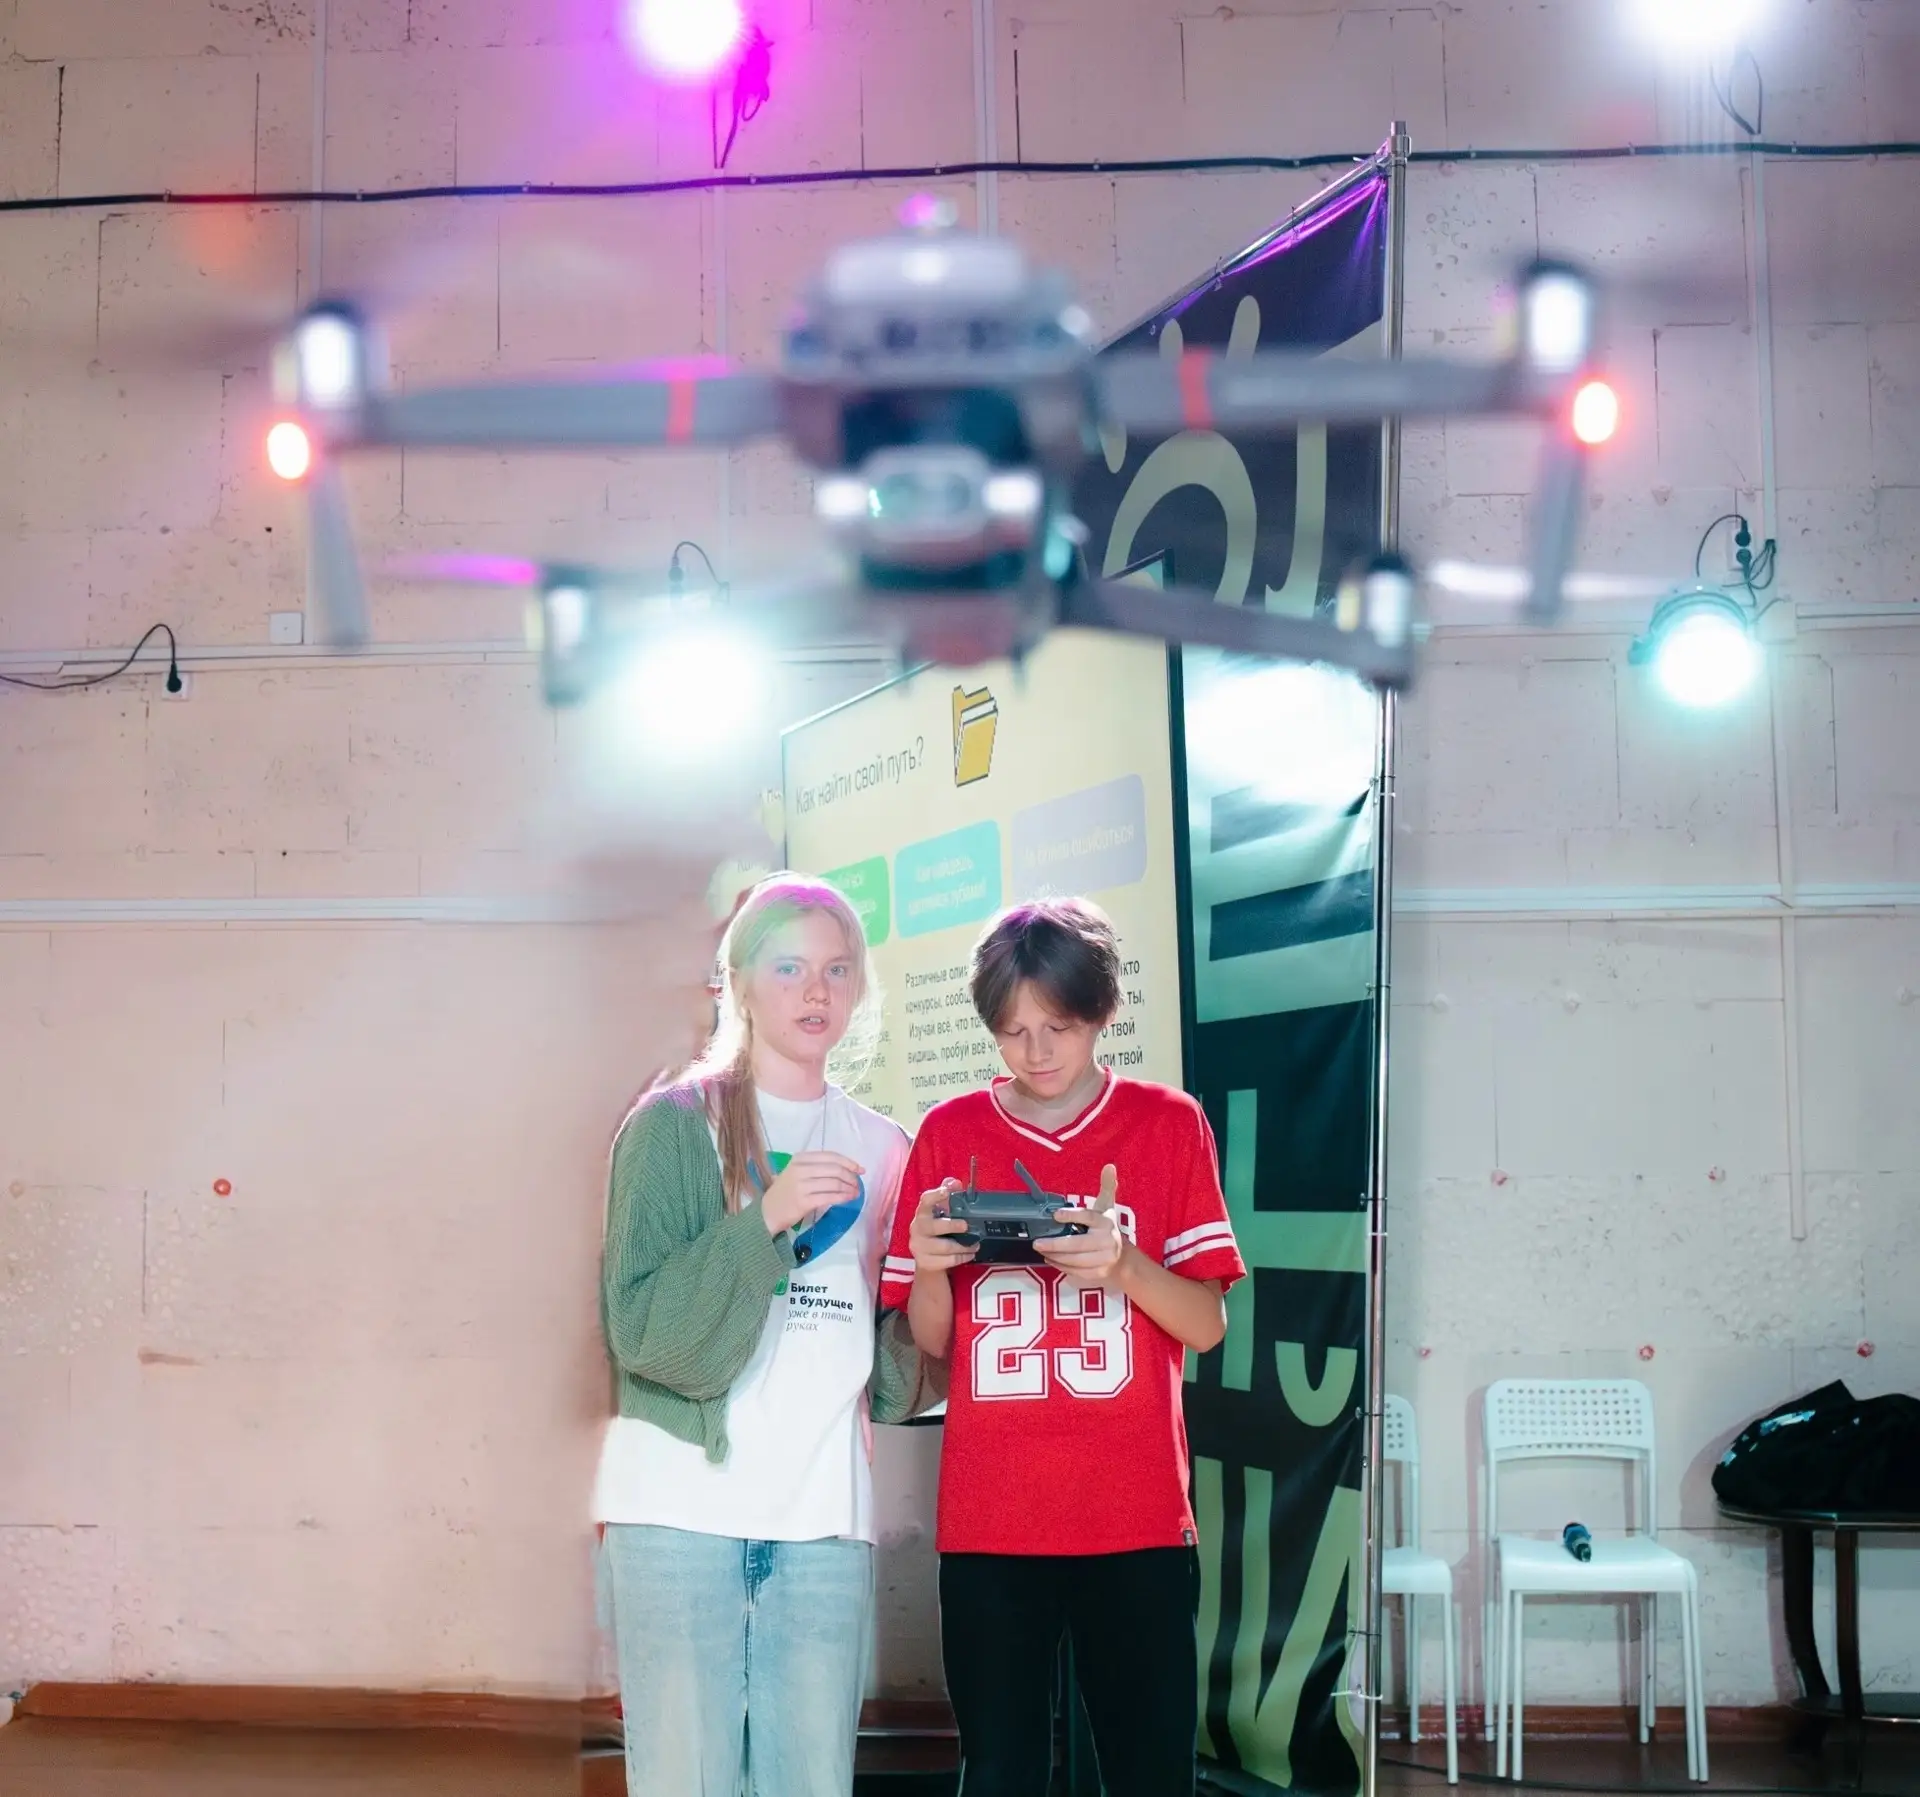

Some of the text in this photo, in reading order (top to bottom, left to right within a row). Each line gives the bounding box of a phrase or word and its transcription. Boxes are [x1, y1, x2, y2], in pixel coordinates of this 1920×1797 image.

[796, 786, 816, 815] Как
[818, 771, 852, 807] найти
[854, 754, 884, 791] свой
[887, 735, 925, 784] путь?
[905, 968, 947, 988] Различные
[1127, 990, 1145, 1006] ты,
[909, 1020, 937, 1042] Изучай
[955, 1017, 969, 1032] что
[1111, 1017, 1135, 1036] твой
[941, 1040, 970, 1062] пробуй
[1118, 1045, 1143, 1066] твой
[911, 1074, 937, 1090] только
[939, 1069, 971, 1087] хочется,
[791, 1282, 828, 1293] Билет
[789, 1296, 853, 1310] в будущее
[788, 1309, 853, 1323] уже в твоих
[785, 1321, 819, 1332] руках
[971, 1266, 1133, 1401] 23
